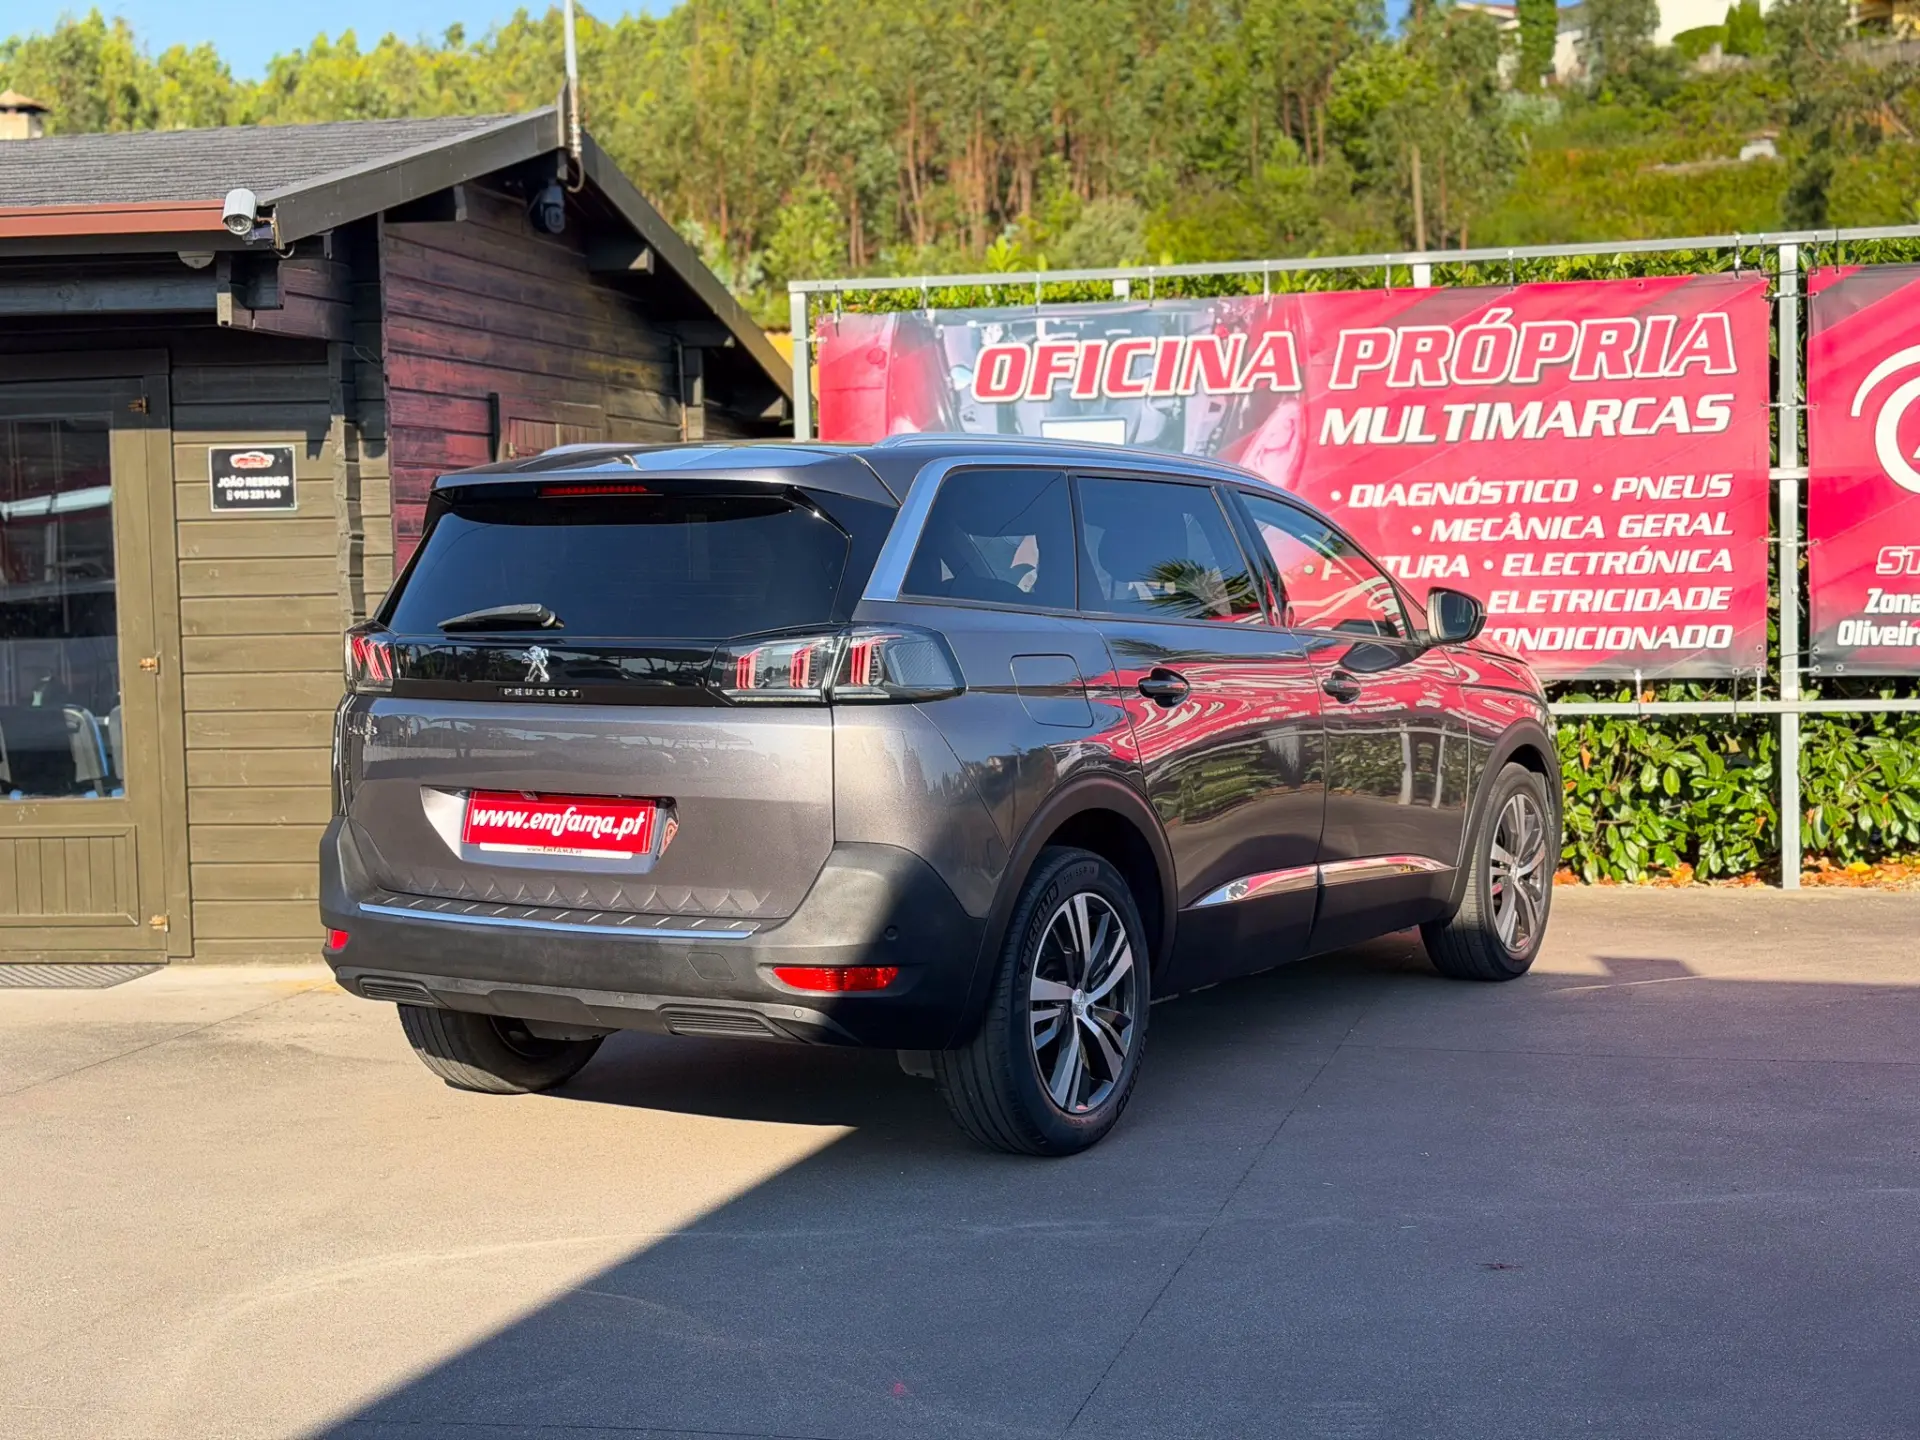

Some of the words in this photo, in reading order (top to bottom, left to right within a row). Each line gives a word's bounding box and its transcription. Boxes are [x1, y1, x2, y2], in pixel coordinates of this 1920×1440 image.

[971, 330, 1302, 403] OFICINA
[1328, 308, 1738, 391] PRÓPRIA
[1319, 393, 1734, 446] MULTIMARCAS
[1348, 476, 1579, 508] DIAGNÓSTICO
[1611, 473, 1733, 501] PNEUS
[1429, 511, 1606, 542] MECÂNICA
[1617, 511, 1735, 539] GERAL
[1321, 554, 1470, 582] PTURA
[1501, 545, 1734, 577] ELECTRÓNICA
[1486, 586, 1733, 614] ELETRICIDADE
[1481, 624, 1734, 651] ONDICIONADO
[1837, 619, 1920, 646] Oliveir
[503, 687, 579, 697] PEUGEOT
[472, 807, 645, 840] www.emfama.pt
